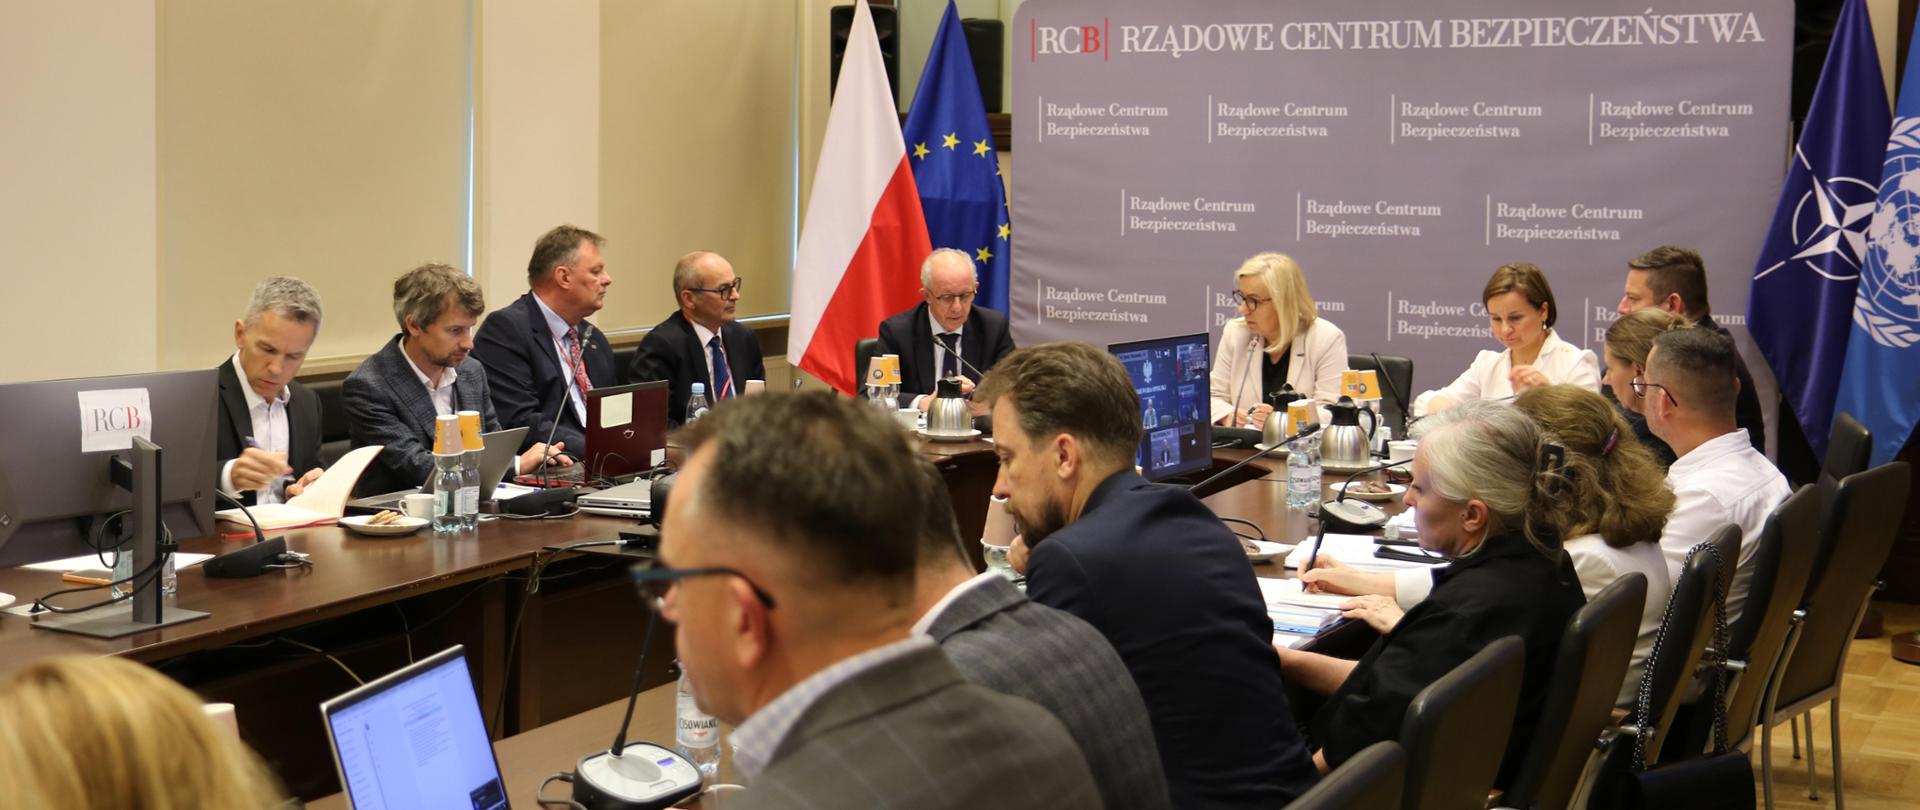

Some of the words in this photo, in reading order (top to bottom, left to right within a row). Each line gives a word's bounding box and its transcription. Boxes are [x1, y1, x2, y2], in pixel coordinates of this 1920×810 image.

[1038, 24, 1101, 54] RCB
[1120, 23, 1273, 58] RZĄDOWE
[1281, 20, 1442, 50] CENTRUM
[1449, 8, 1765, 47] BEZPIECZEŃSTWA
[1048, 104, 1105, 119] Rządowe
[1109, 103, 1168, 116] Centrum
[1218, 103, 1280, 119] Rządowe
[1284, 103, 1348, 116] Centrum
[1402, 102, 1469, 119] Rządowe
[1473, 102, 1542, 116] Centrum
[1600, 101, 1673, 119] Rządowe
[1679, 101, 1753, 115] Centrum
[1048, 123, 1149, 139] Bezpieczeństwa
[1218, 123, 1328, 140] Bezpieczeństwa
[1401, 123, 1520, 140] Bezpieczeństwa
[1601, 123, 1729, 141] Bezpieczeństwa
[1130, 197, 1190, 213] Rządowe
[1194, 198, 1255, 212] Centrum
[1307, 200, 1371, 217] Rządowe
[1376, 201, 1441, 216] Centrum
[1497, 203, 1567, 221] Rządowe
[1572, 204, 1643, 219] Centrum
[1131, 216, 1236, 233] Bezpieczeństwa
[1307, 220, 1420, 238] Bezpieczeństwa
[1497, 224, 1620, 242] Bezpieczeństwa
[1046, 287, 1104, 303] Rządowe
[1108, 289, 1166, 304] Centrum
[1046, 305, 1148, 322] Bezpieczeństwa
[1398, 300, 1465, 318] Rządowe
[1398, 320, 1493, 339] Bezpieczeńst
[94, 406, 140, 432] RCB
